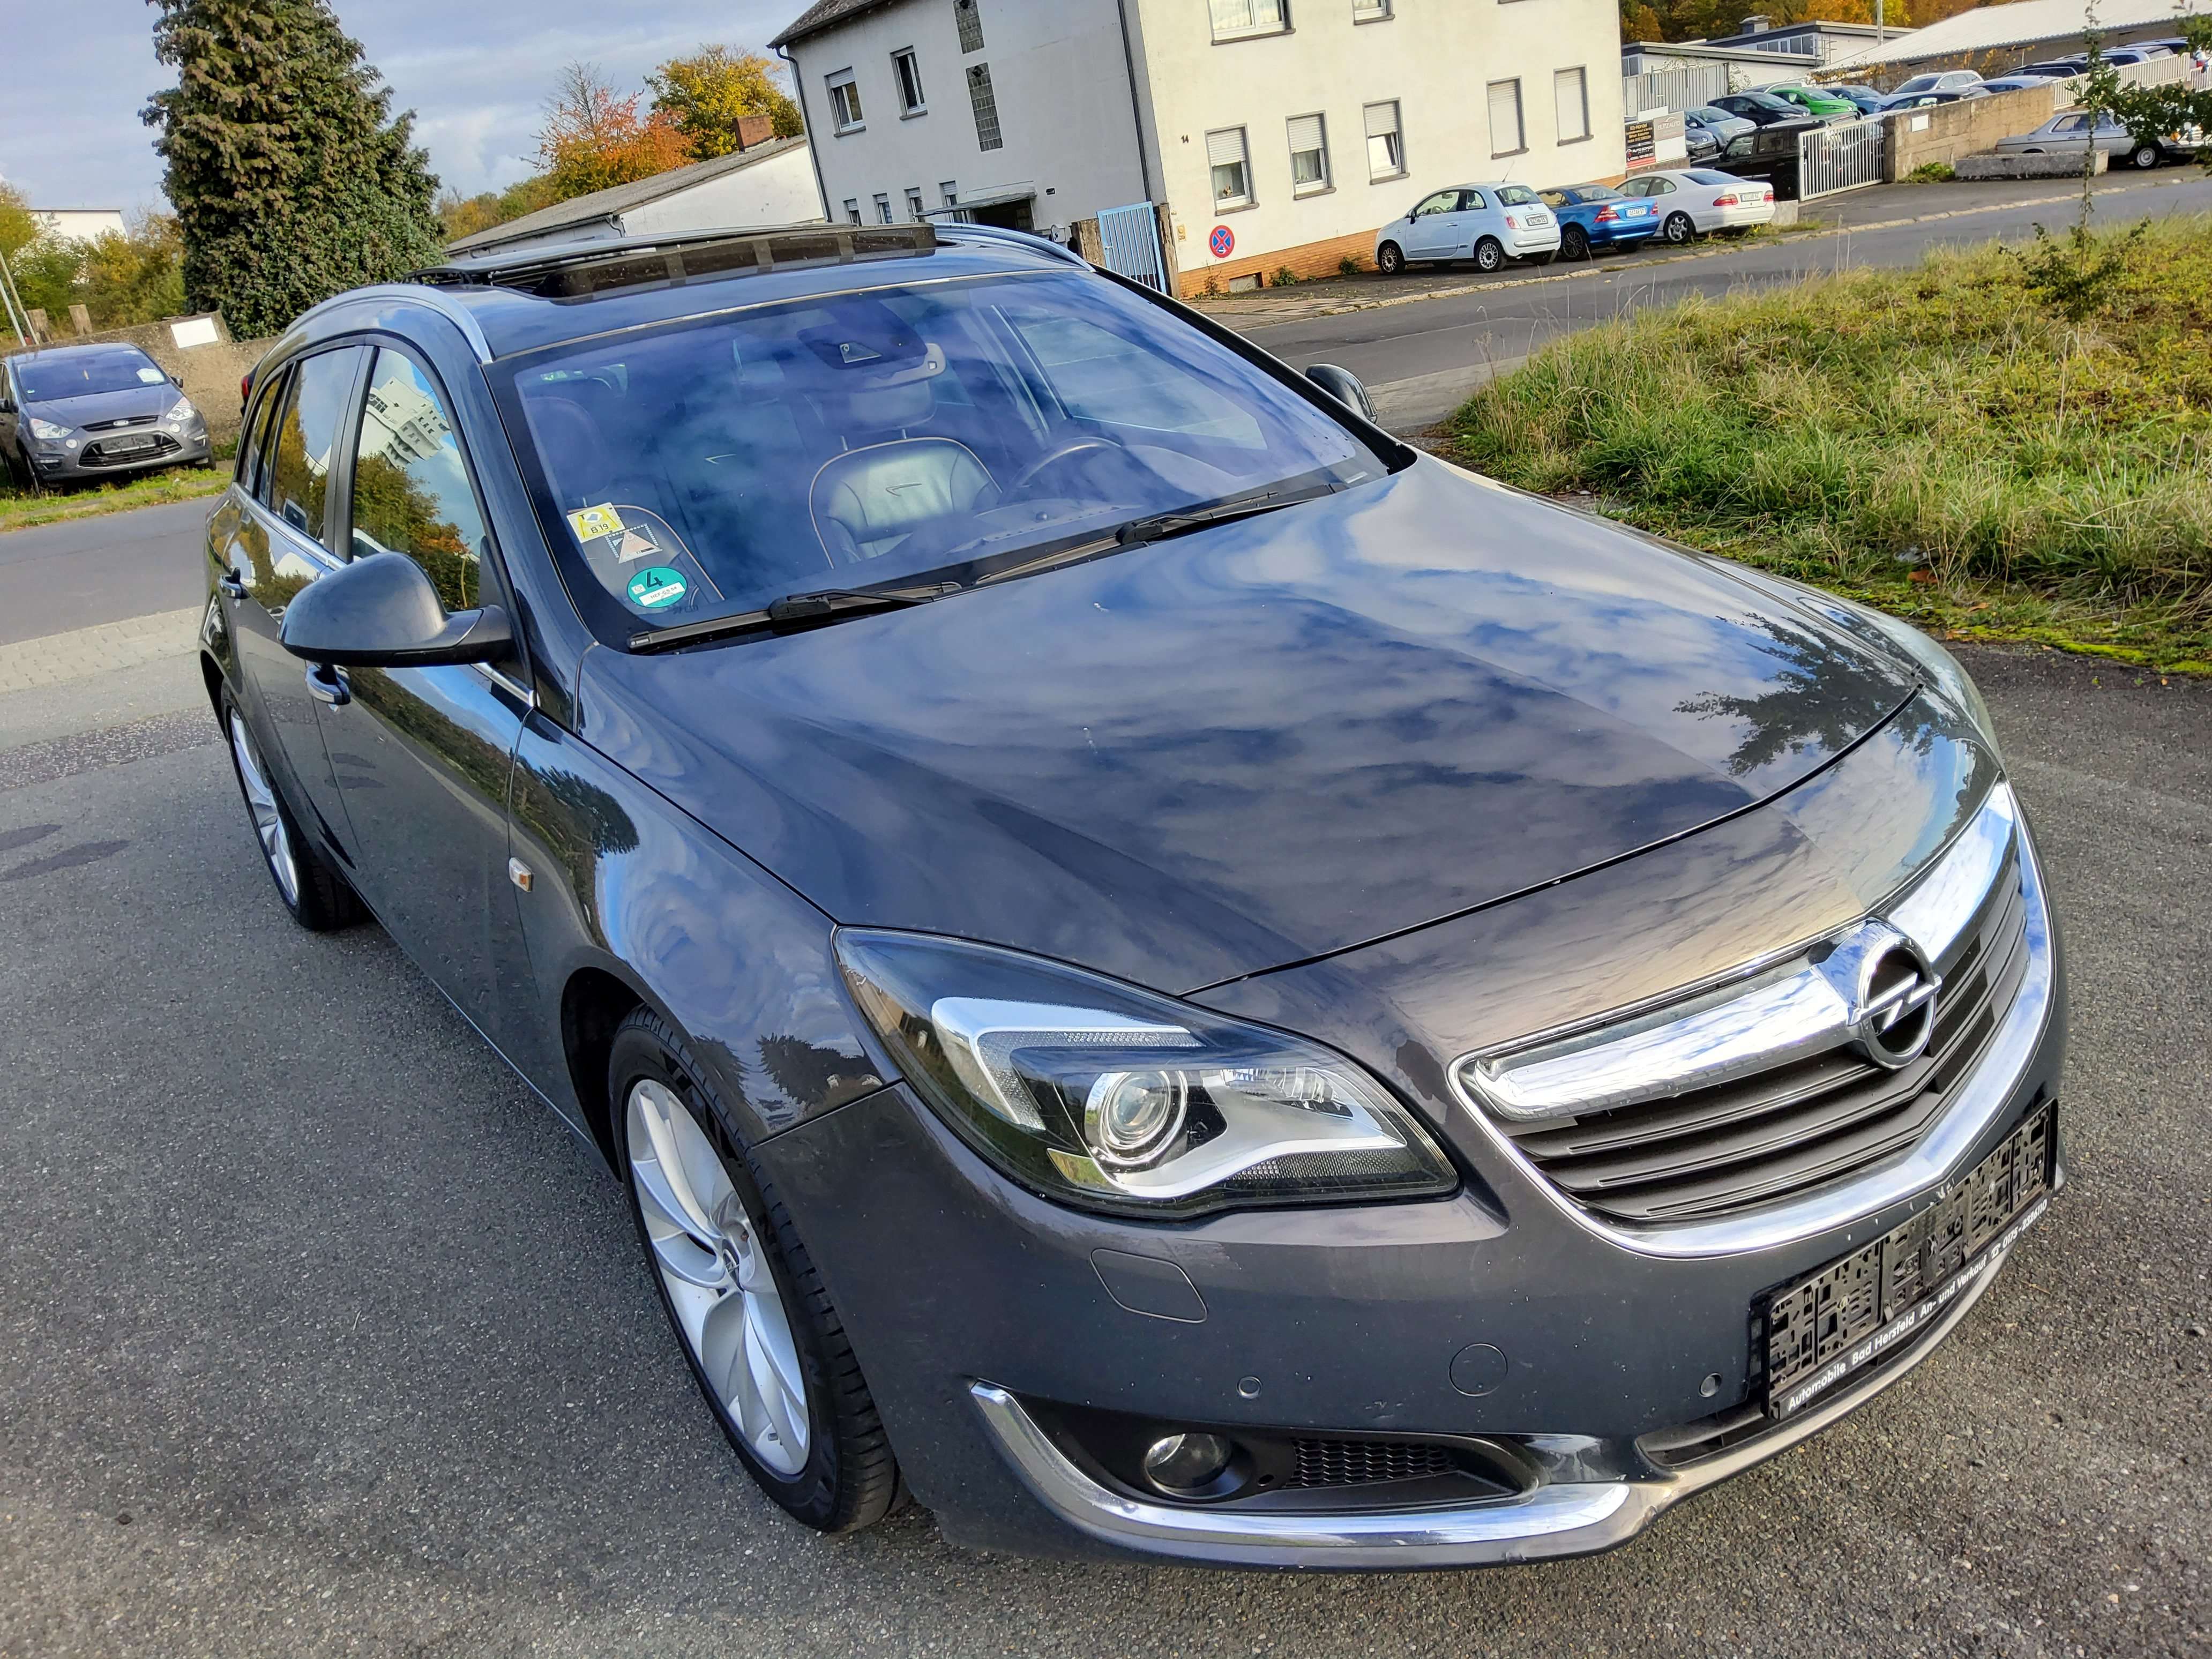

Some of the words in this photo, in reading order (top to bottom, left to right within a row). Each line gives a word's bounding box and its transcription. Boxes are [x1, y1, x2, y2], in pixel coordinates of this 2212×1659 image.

[1180, 134, 1189, 144] 14
[647, 571, 664, 588] 4
[1788, 1363, 1847, 1411] Automobile
[1852, 1341, 1872, 1365] Bad
[1875, 1311, 1915, 1350] Hersfeld
[1920, 1301, 1937, 1318] An-
[1939, 1281, 1955, 1304] und
[1957, 1254, 1987, 1288] Verkauf
